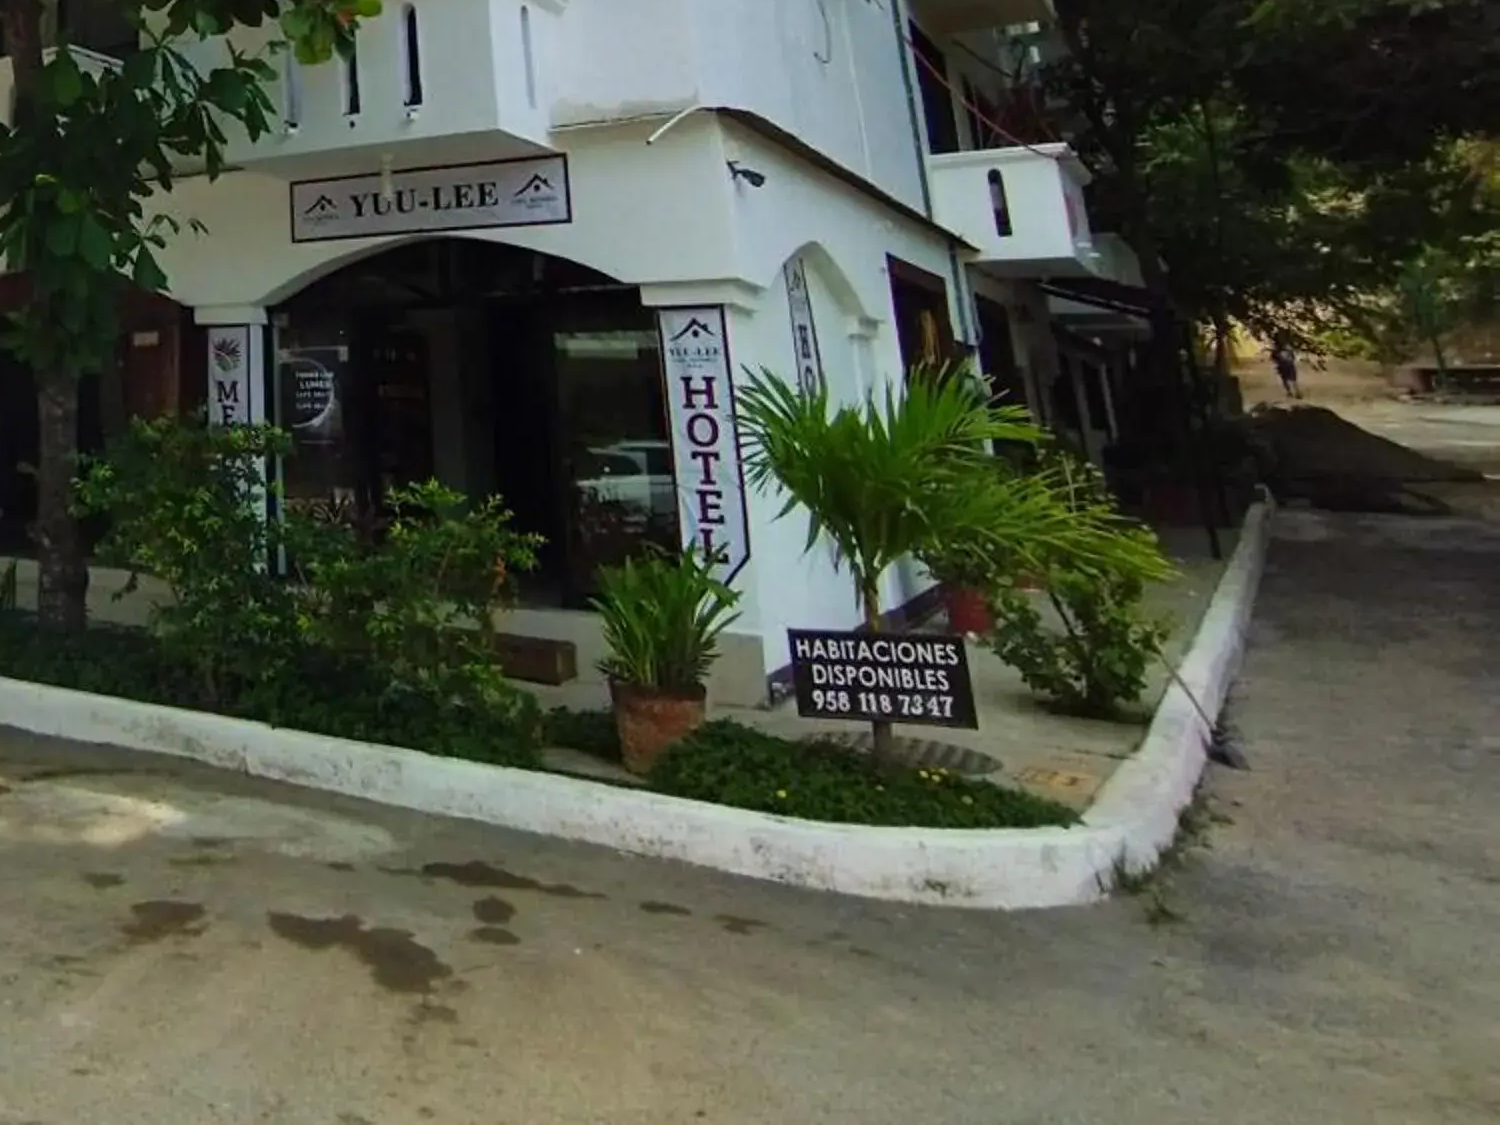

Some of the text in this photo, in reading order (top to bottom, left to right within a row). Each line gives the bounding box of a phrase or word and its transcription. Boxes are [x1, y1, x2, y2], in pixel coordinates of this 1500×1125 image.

[681, 376, 729, 564] HOTEL
[797, 638, 959, 665] HABITACIONES
[812, 665, 950, 690] DISPONIBLES
[812, 690, 954, 718] 958 118 7347
